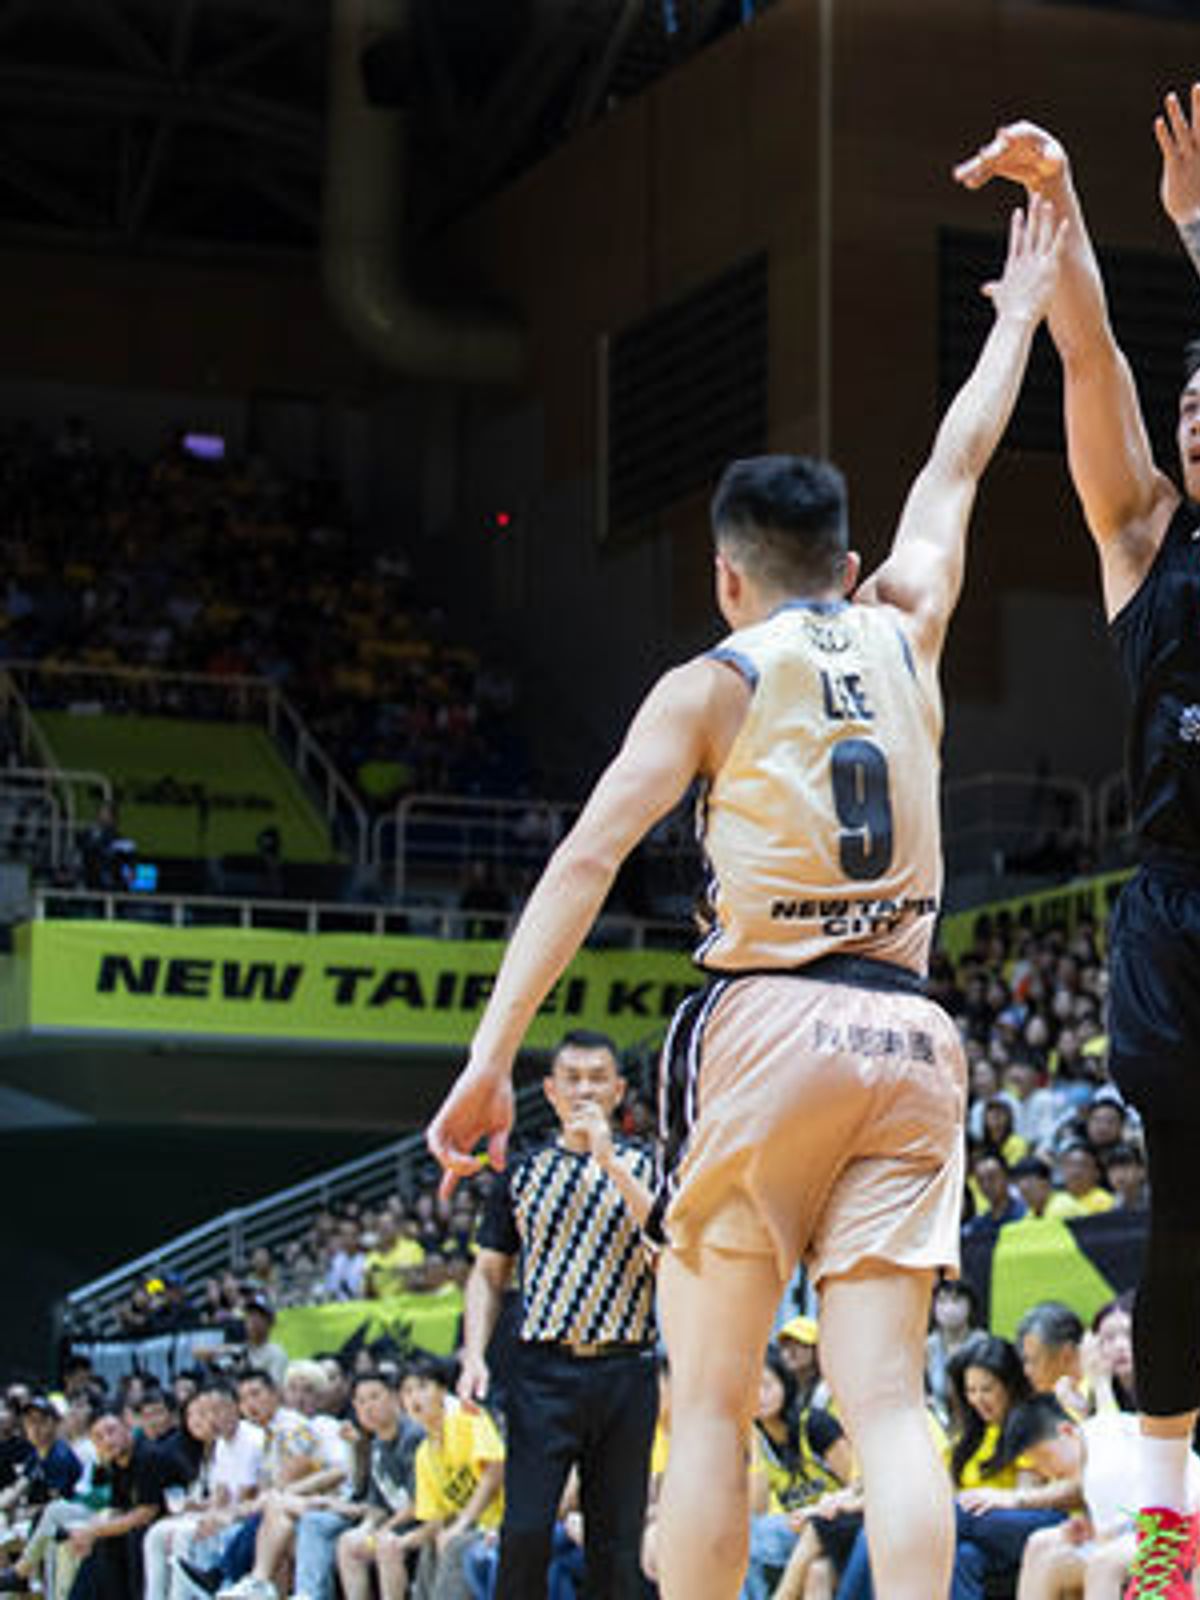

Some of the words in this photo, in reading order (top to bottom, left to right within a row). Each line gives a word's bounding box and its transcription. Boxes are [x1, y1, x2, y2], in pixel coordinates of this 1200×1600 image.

[831, 738, 893, 882] 9
[772, 899, 849, 918] NEW
[97, 954, 303, 1002] NEW
